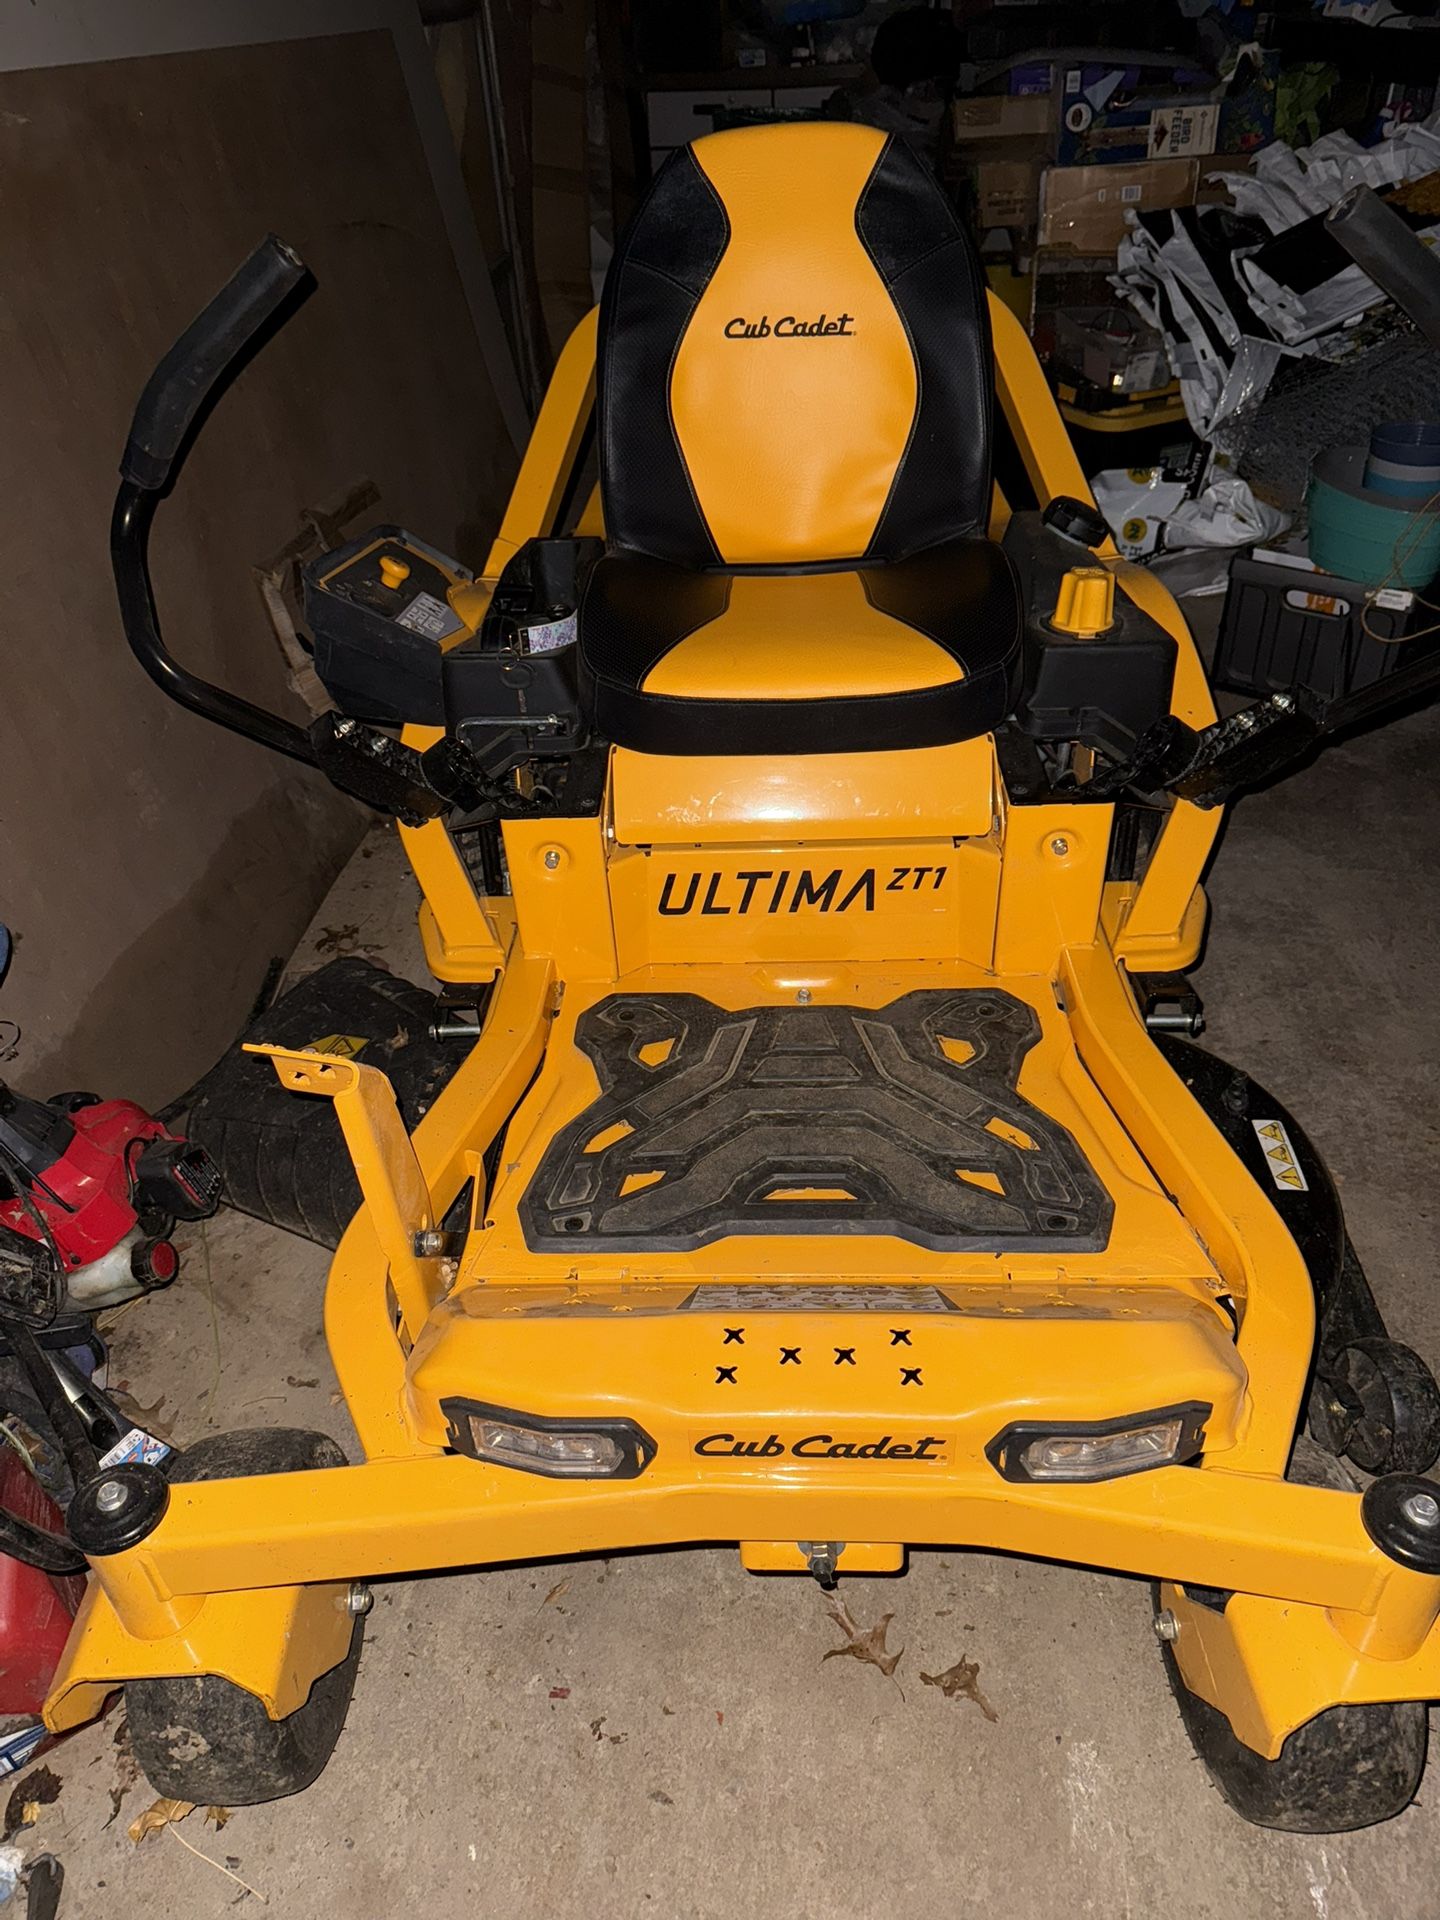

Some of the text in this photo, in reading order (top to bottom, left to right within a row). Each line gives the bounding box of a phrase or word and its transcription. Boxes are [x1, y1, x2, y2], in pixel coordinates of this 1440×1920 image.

[1170, 110, 1183, 153] FEEDER
[1182, 118, 1193, 144] BIRD
[724, 313, 854, 339] Cub Cadet
[658, 866, 948, 916] ULTIMA ZT1
[694, 1433, 947, 1460] Cub Cadet
